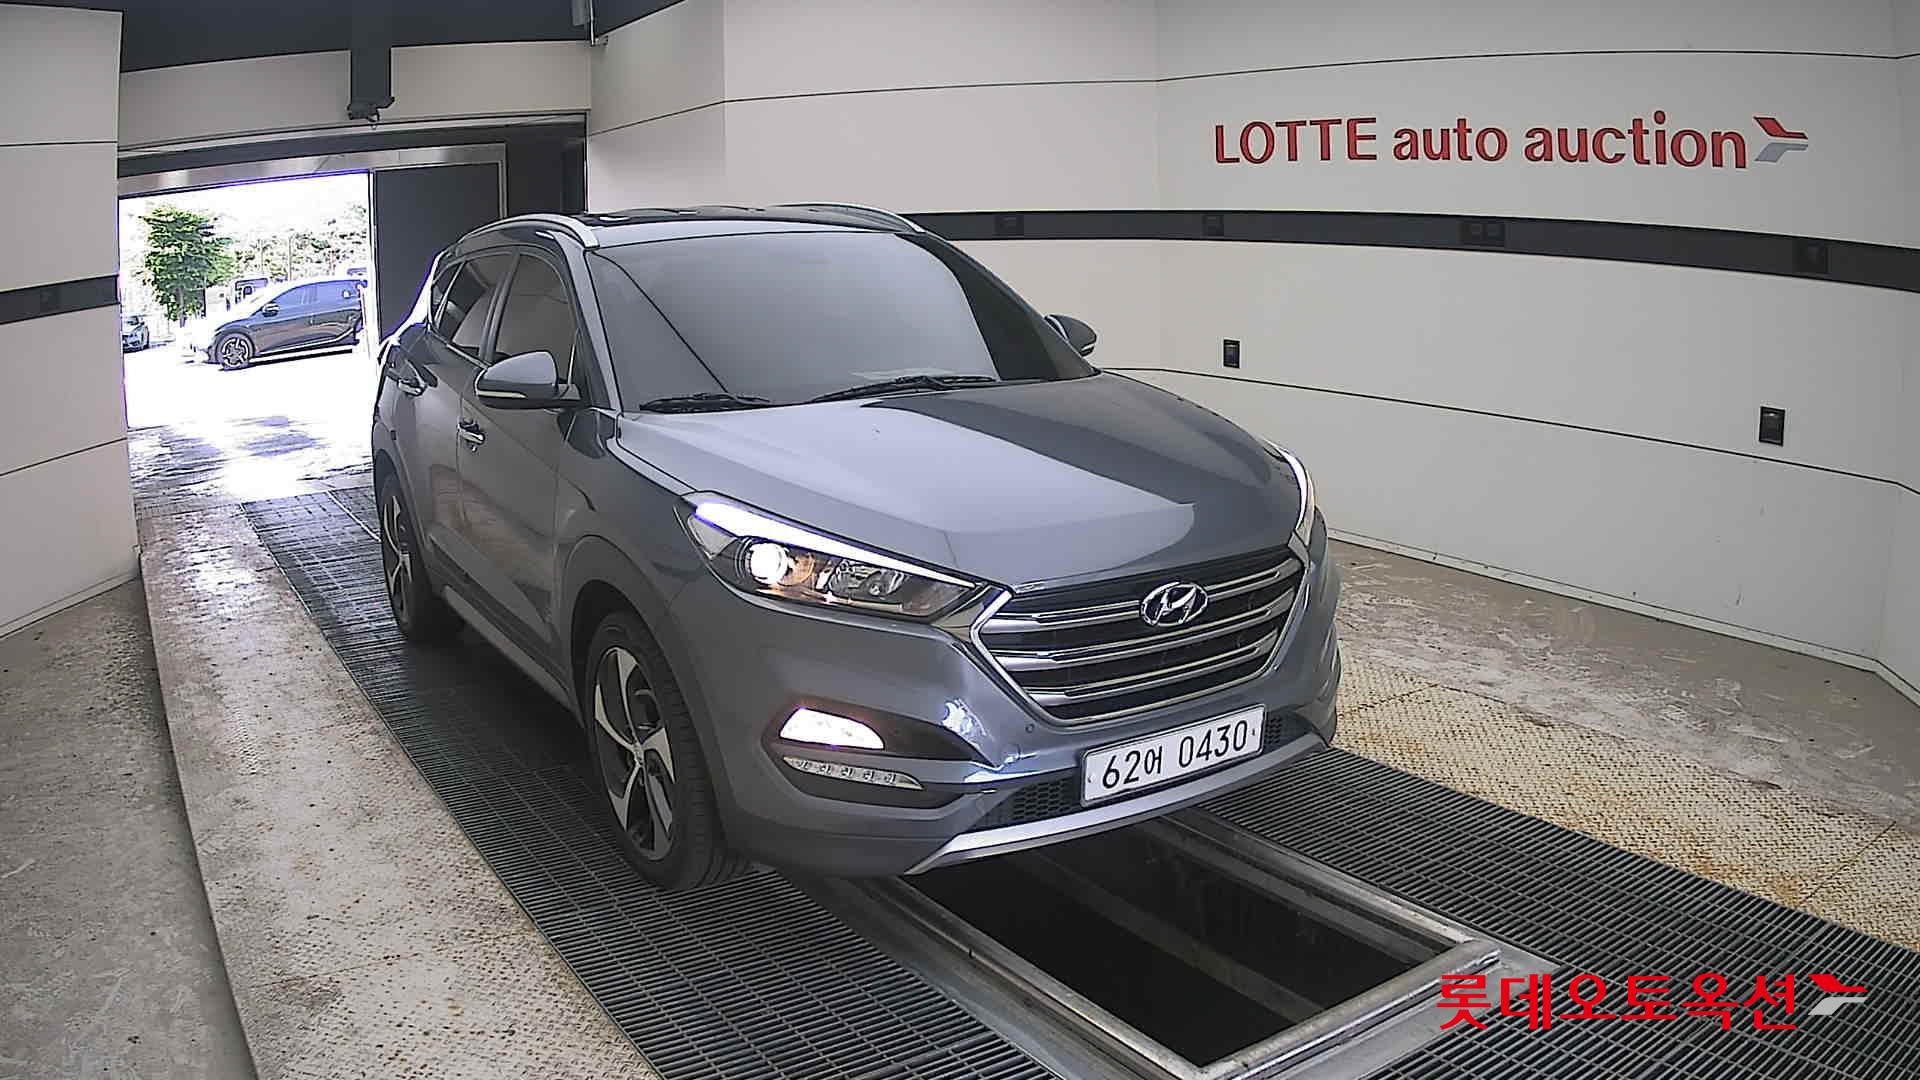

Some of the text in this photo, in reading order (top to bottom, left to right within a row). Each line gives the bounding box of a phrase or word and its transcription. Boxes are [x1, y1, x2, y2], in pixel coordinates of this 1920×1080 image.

[1215, 110, 1746, 169] LOTTE auto auction
[1102, 720, 1248, 789] 62어 0430
